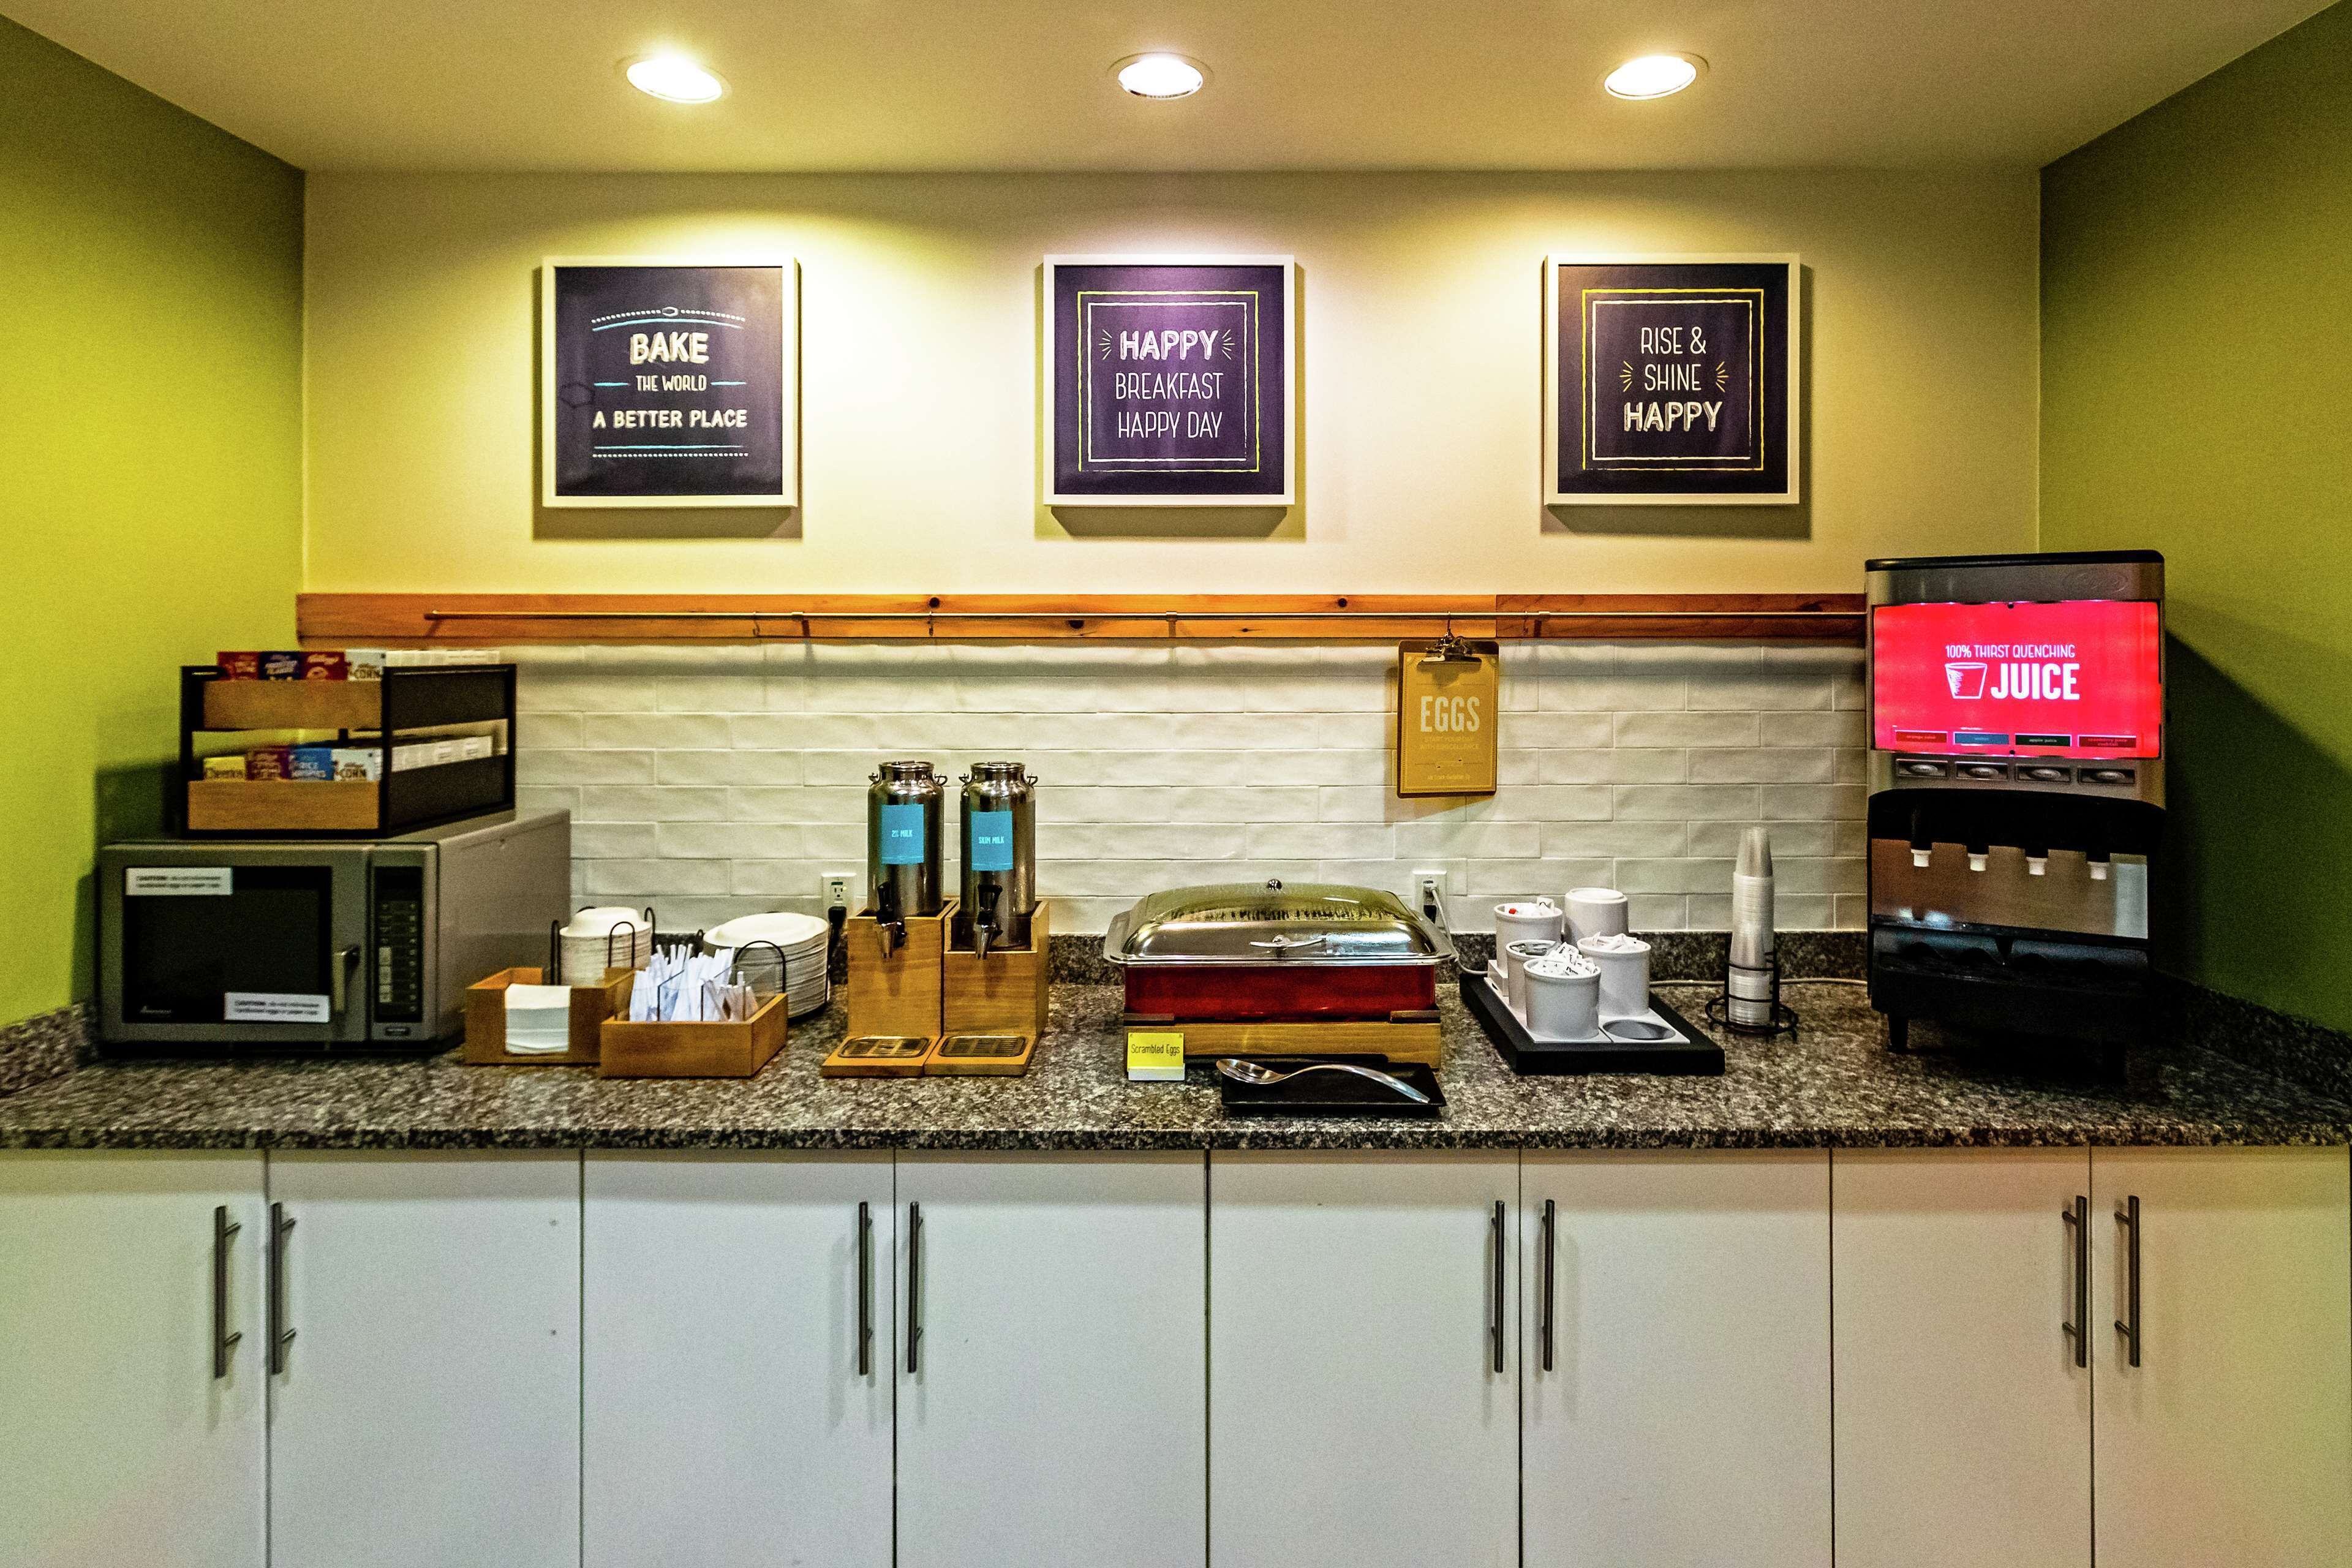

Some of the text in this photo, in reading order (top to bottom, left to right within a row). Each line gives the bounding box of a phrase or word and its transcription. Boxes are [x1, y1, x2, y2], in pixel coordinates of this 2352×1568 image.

[630, 332, 709, 364] BAKE
[1120, 330, 1218, 360] HAPPY
[1641, 326, 1706, 355] RISE &
[636, 375, 707, 392] THE WORLD
[1115, 372, 1223, 399] BREAKFAST
[1645, 364, 1702, 391] SHINE
[593, 409, 747, 428] A BETTER PLACE
[1118, 412, 1223, 438] HAPPY DAY
[1624, 401, 1723, 432] HAPPY
[1945, 644, 2076, 658] 100% THIRST QUENCHING
[1991, 663, 2080, 700] JUICE
[1420, 695, 1480, 733] EGGS
[1131, 1044, 1180, 1056] Scrambled Eggs
